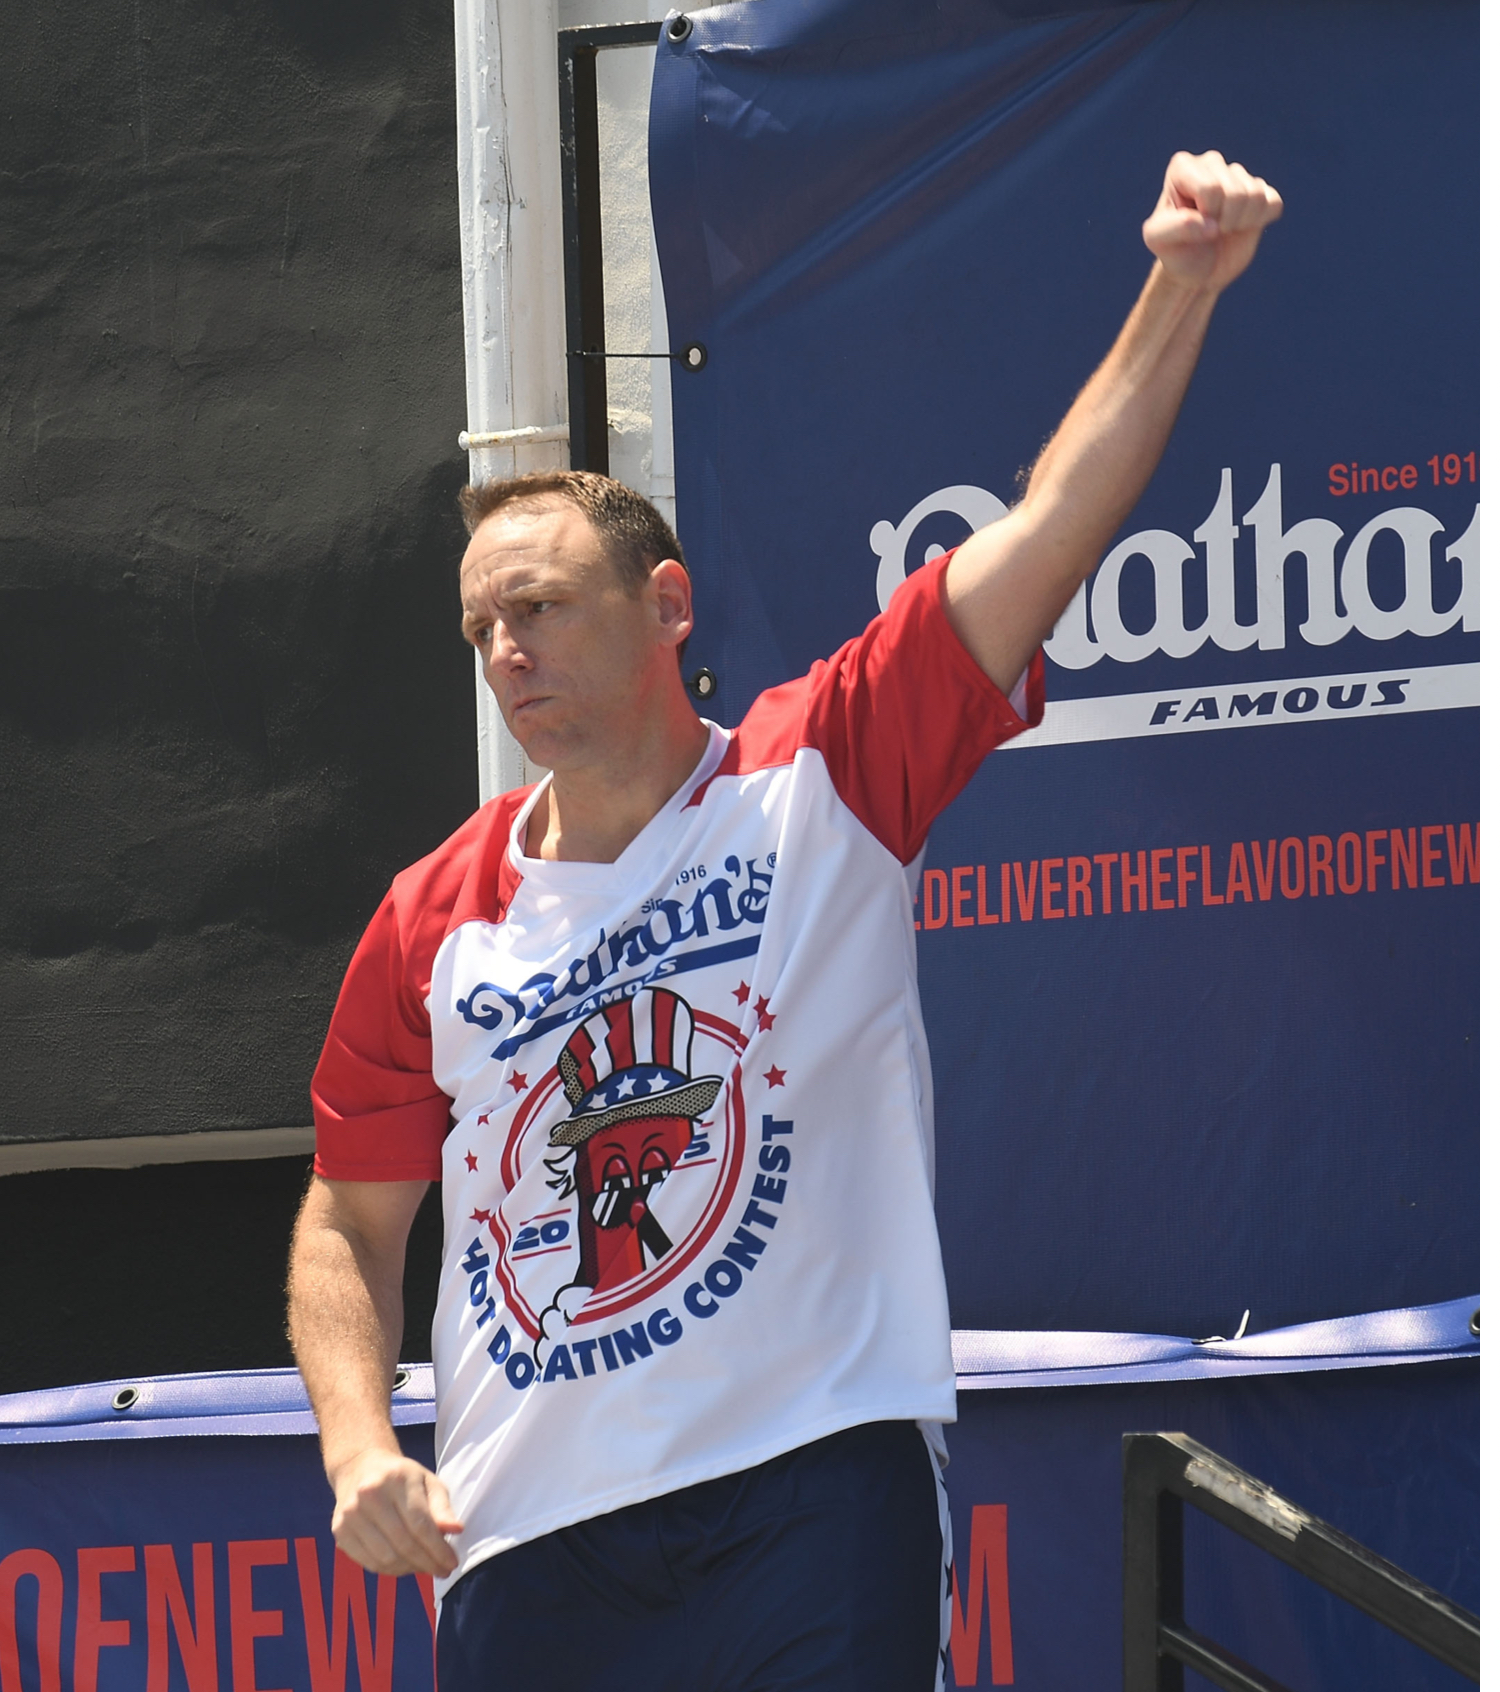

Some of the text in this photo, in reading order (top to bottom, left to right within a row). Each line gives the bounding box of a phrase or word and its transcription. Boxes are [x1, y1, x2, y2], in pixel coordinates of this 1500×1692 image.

[1328, 450, 1480, 497] Since 191
[1149, 678, 1411, 726] FAMOUS
[914, 822, 1480, 931] DELIVERTHEFLAVOROFNEW
[566, 958, 678, 1020] FAMOS
[461, 1236, 497, 1331] HOT
[683, 1114, 794, 1319] CONTEST
[512, 1219, 570, 1252] 20
